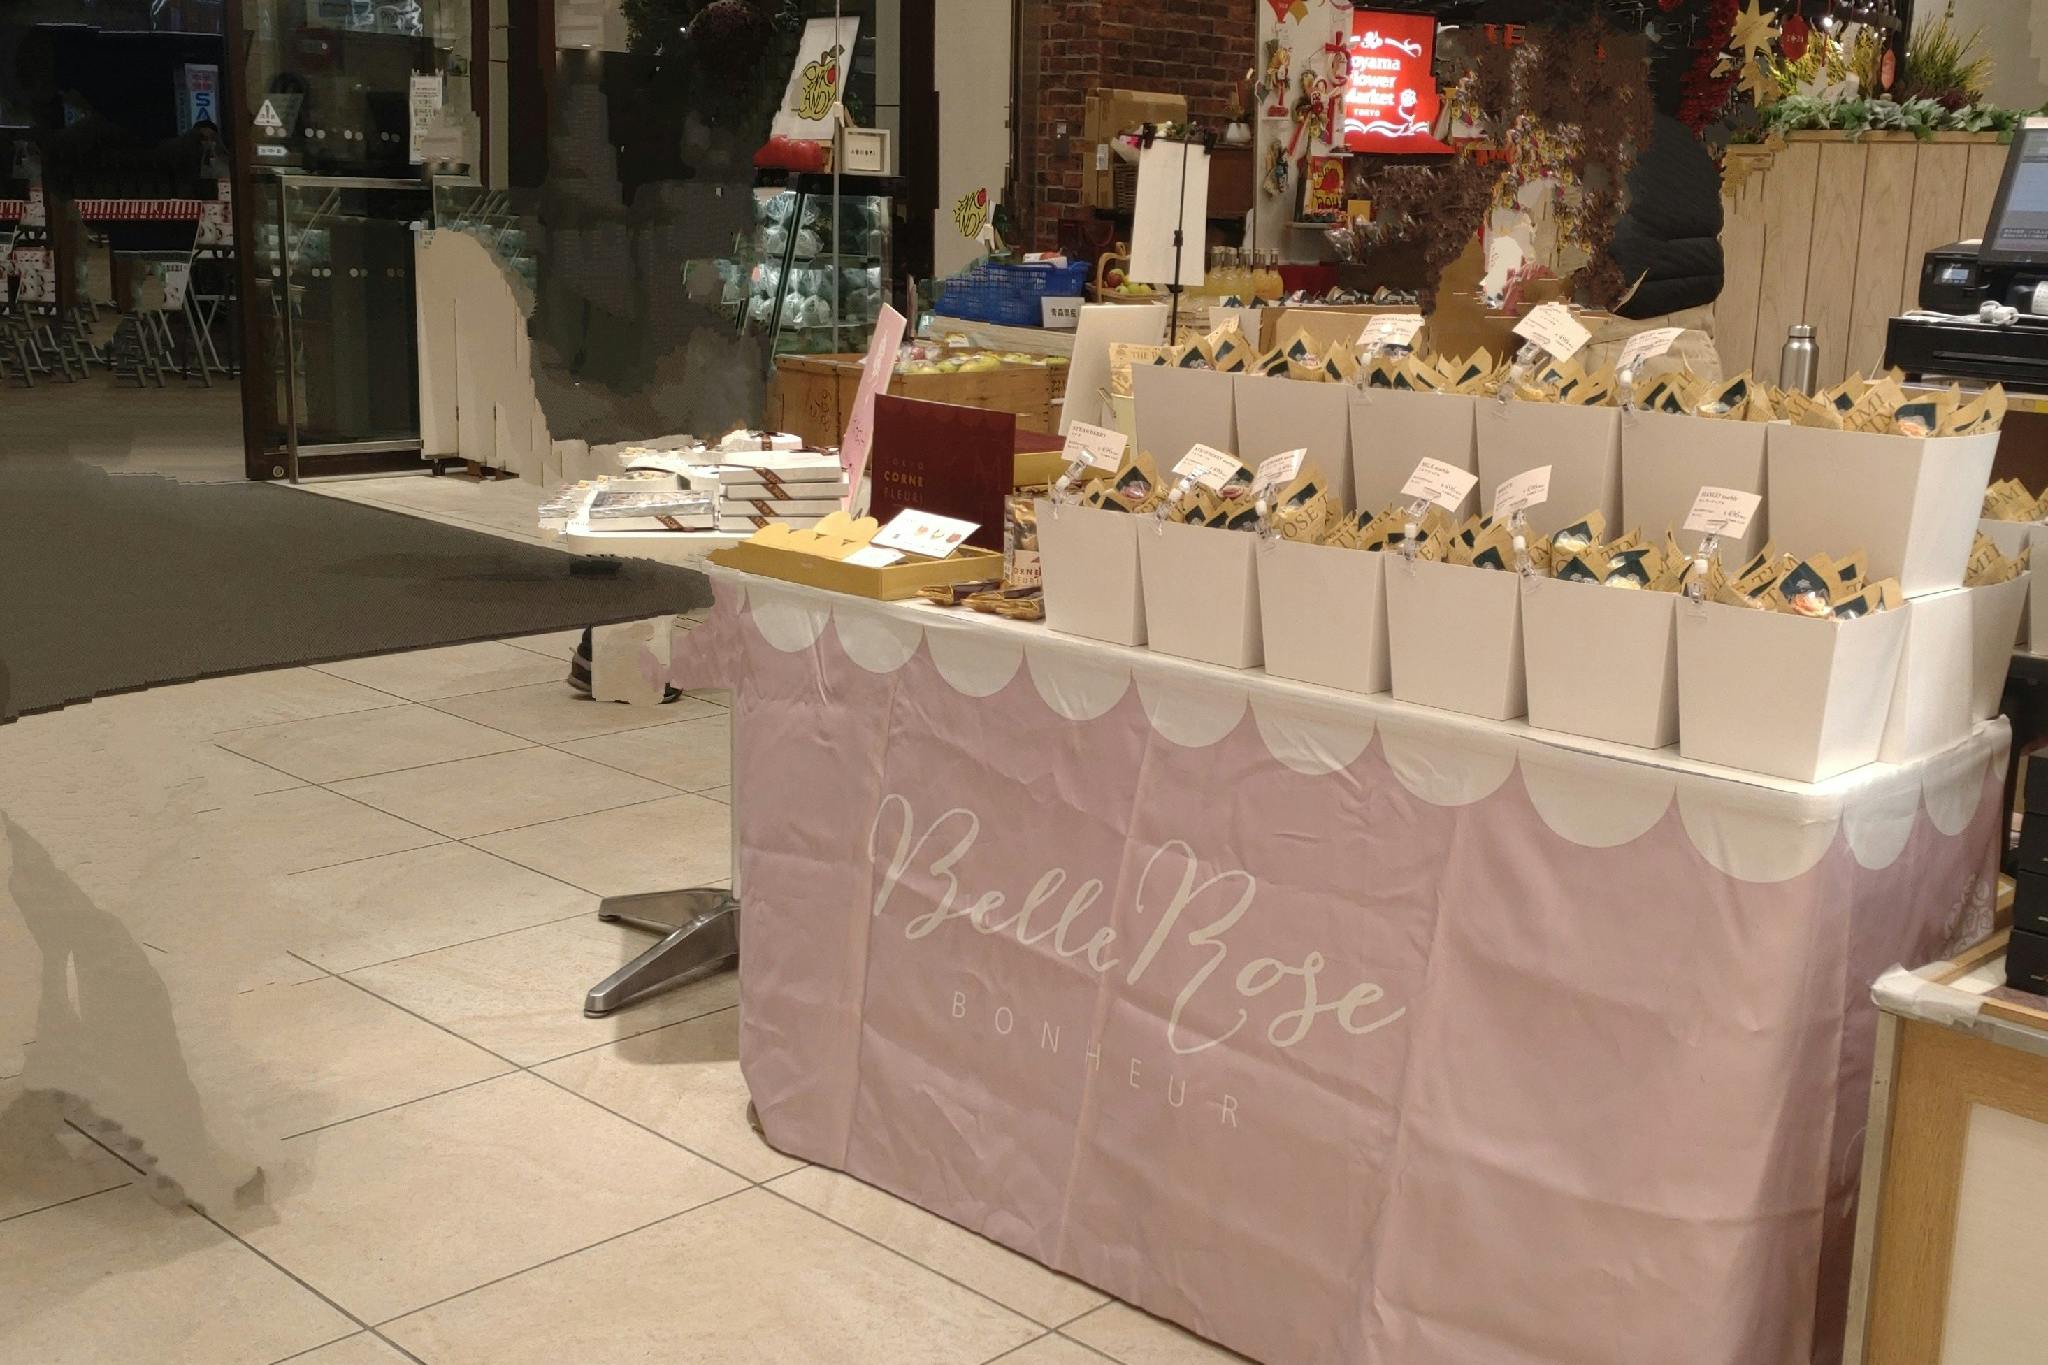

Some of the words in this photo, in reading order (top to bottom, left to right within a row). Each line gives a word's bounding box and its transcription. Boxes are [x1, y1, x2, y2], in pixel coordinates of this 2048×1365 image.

[883, 470, 924, 487] CORNE
[868, 793, 1120, 973] Belle
[1126, 839, 1408, 1055] Rose
[951, 991, 1241, 1128] BONHEUR
